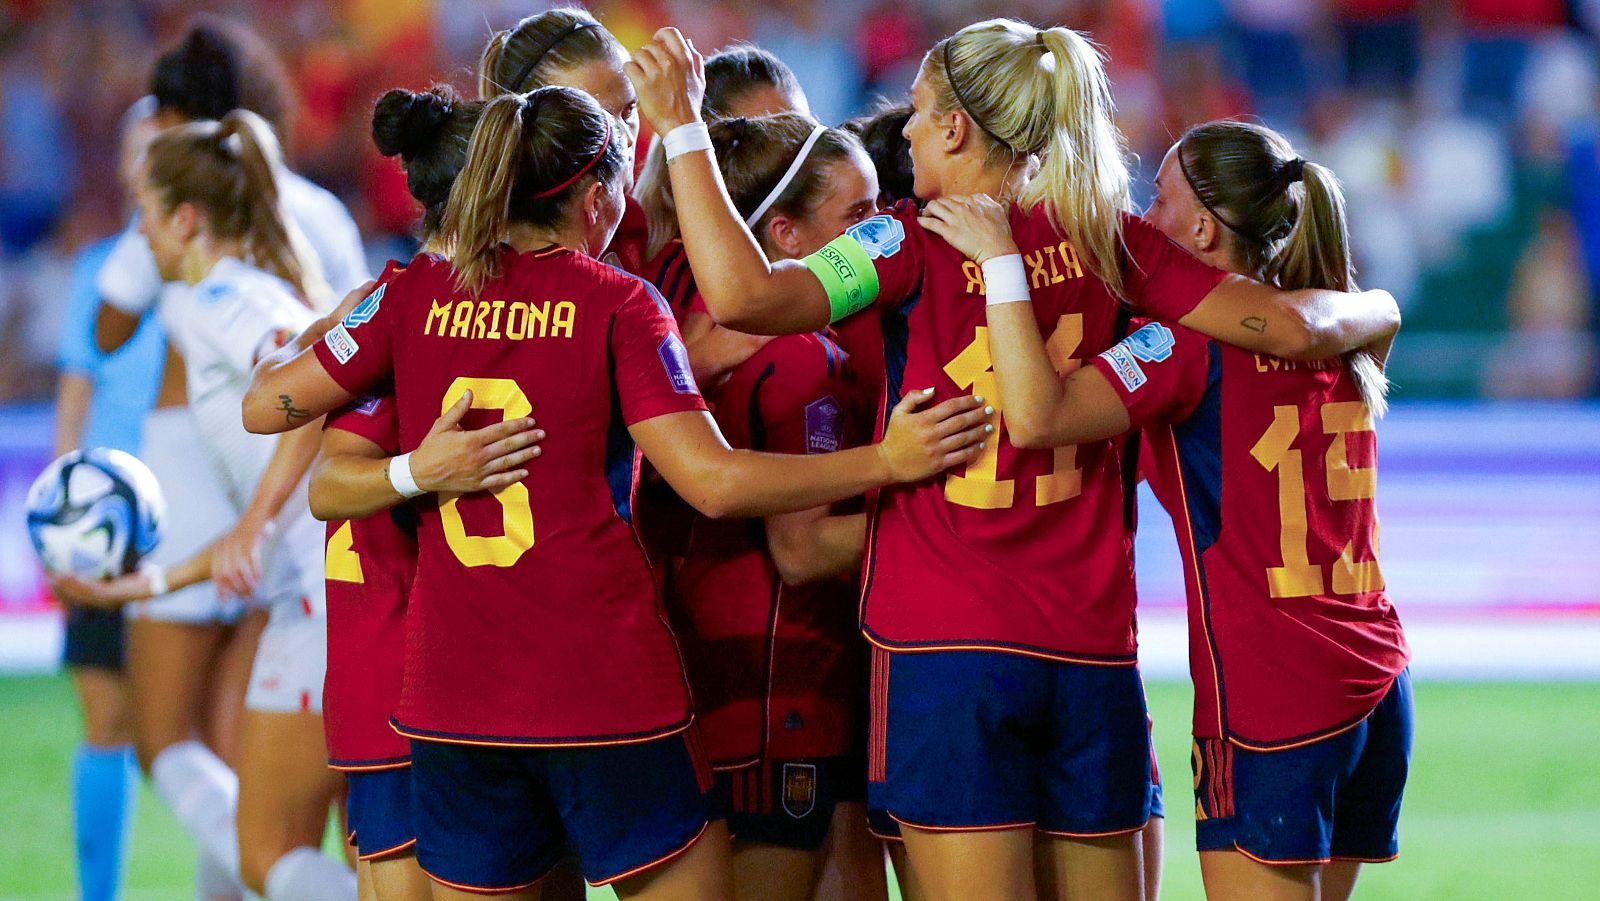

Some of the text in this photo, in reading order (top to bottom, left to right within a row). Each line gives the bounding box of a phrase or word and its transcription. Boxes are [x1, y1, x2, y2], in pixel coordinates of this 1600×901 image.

[424, 298, 576, 341] MARIONA
[961, 241, 1084, 296] AXIA
[439, 376, 535, 567] 8
[943, 313, 1083, 509] 11
[1249, 401, 1386, 598] 19
